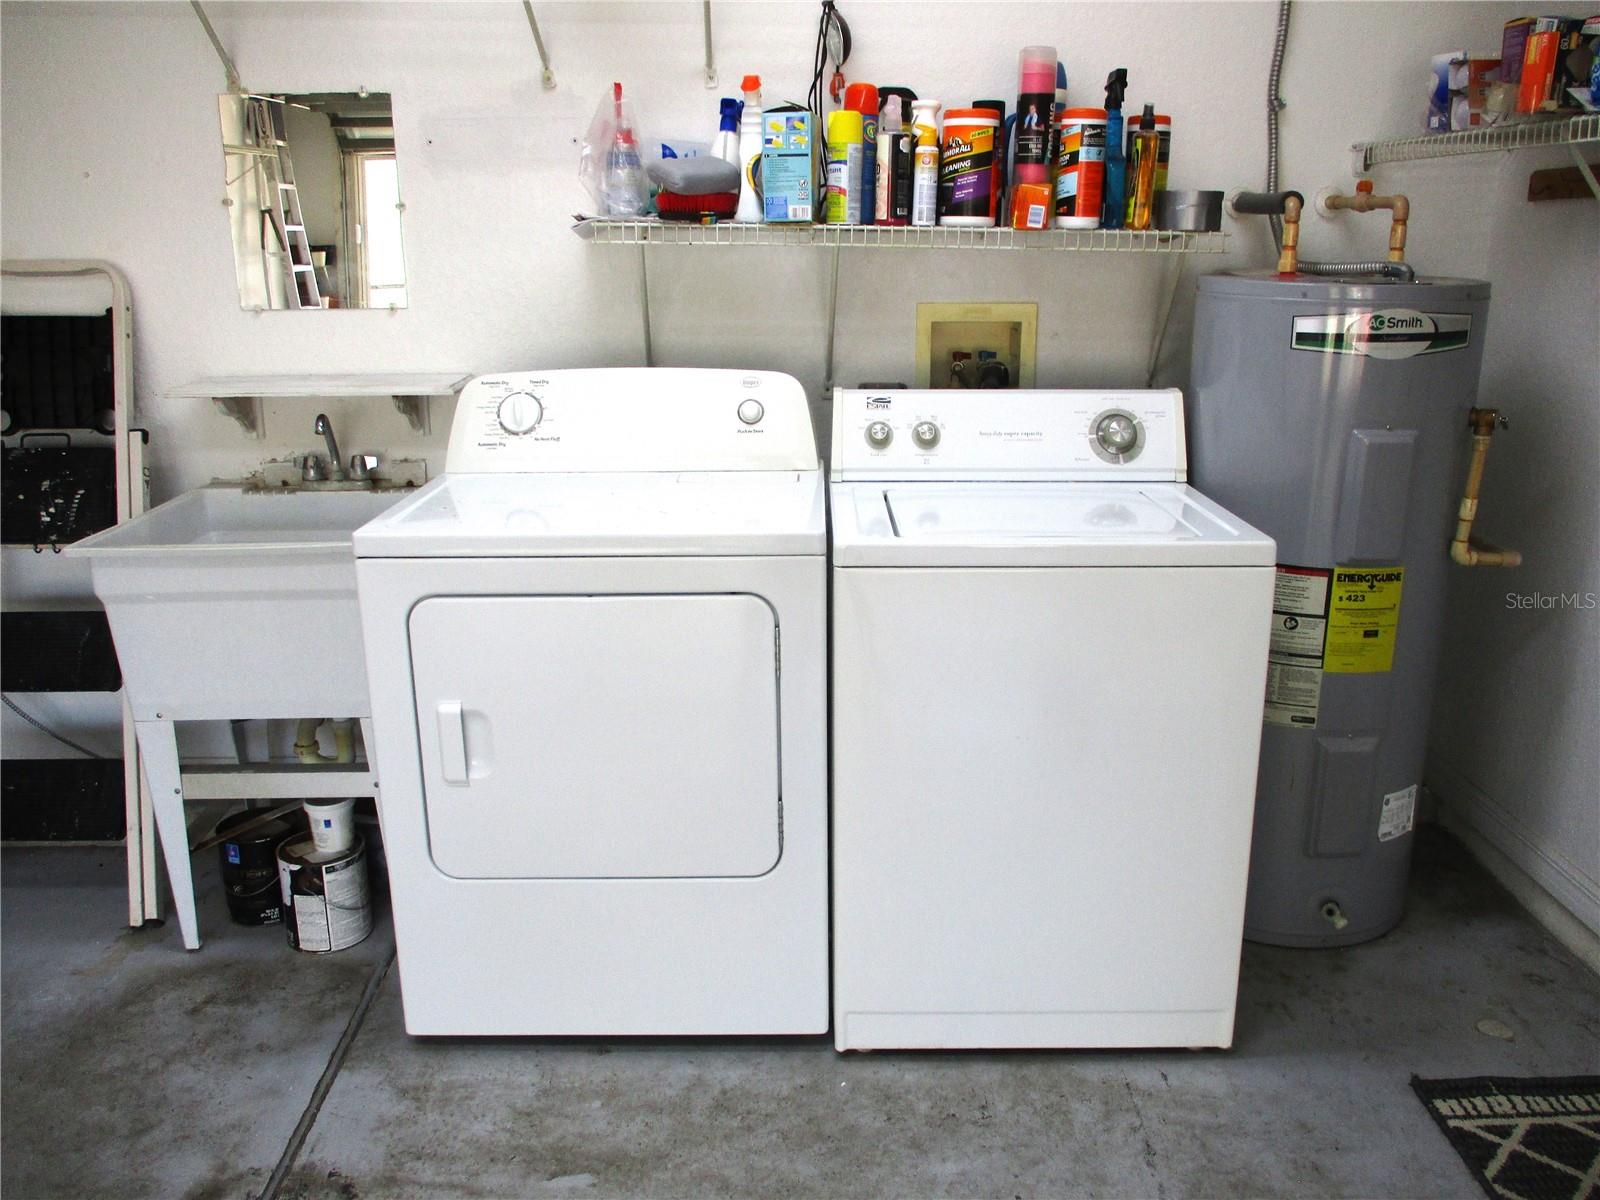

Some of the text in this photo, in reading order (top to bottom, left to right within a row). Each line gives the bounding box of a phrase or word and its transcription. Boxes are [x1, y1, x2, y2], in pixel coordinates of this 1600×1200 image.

[1387, 316, 1423, 329] Smith
[1337, 572, 1402, 583] ENERGYGUIDE
[1346, 594, 1366, 602] 423
